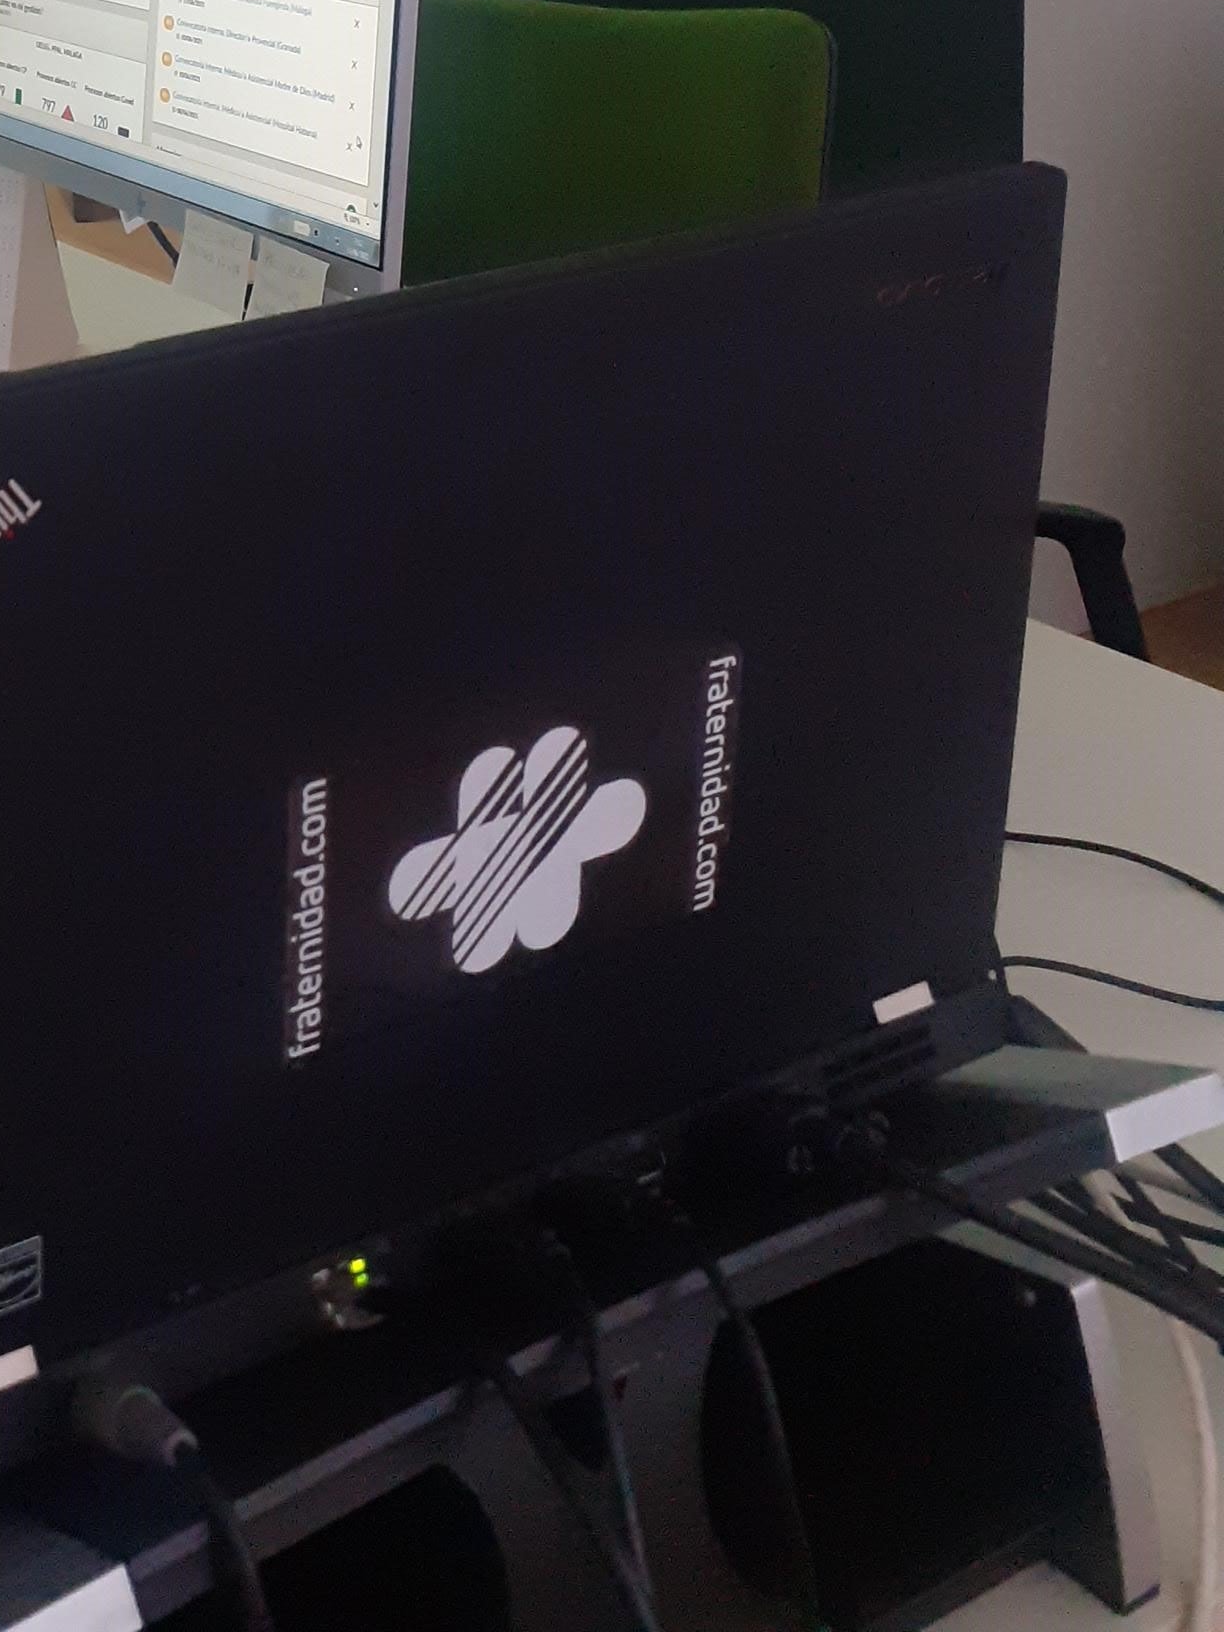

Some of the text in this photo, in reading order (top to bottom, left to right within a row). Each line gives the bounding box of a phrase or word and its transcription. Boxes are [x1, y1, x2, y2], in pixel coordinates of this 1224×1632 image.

[42, 98, 56, 112] 797
[92, 114, 108, 130] 120
[691, 654, 739, 912] fraternidad.com
[287, 776, 329, 1060] fraternidad.com
